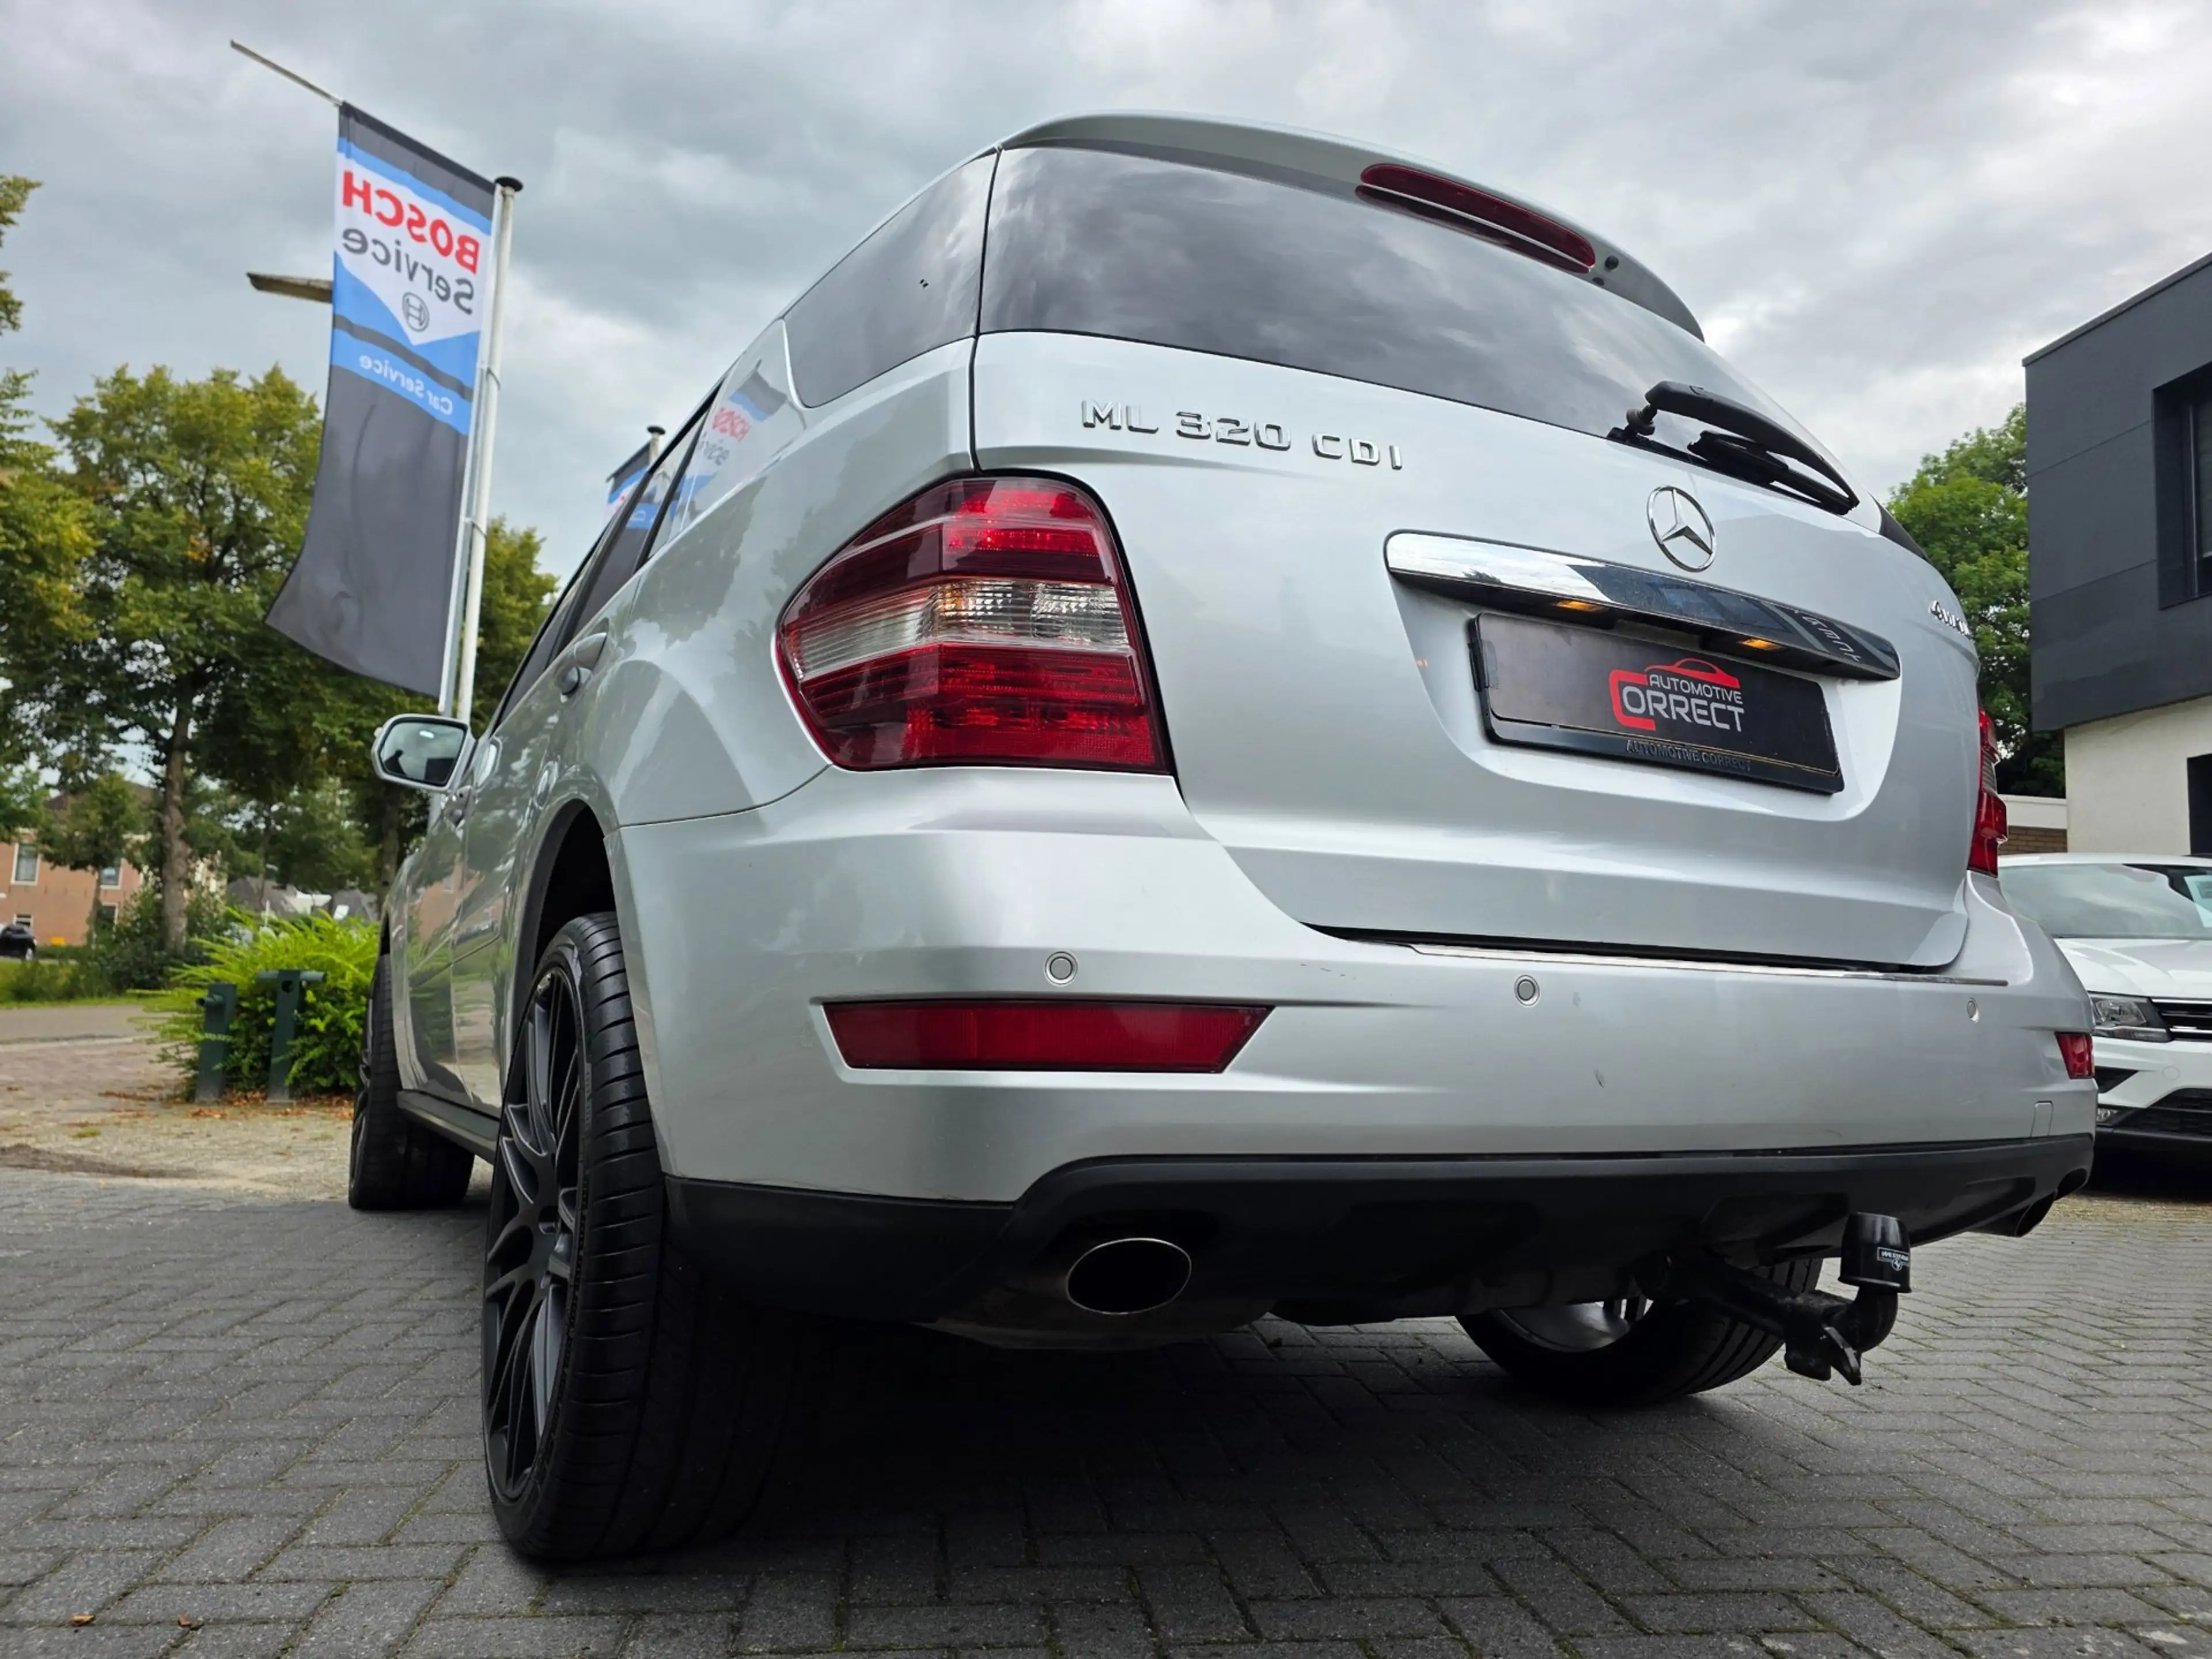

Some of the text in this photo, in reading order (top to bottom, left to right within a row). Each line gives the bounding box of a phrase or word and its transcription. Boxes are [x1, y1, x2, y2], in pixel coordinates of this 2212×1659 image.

[1082, 400, 1403, 470] ML 320 CDI
[1649, 674, 1744, 704] AUTOMOTIVE
[1626, 739, 1753, 771] AUTOMOTIVE CORRECT
